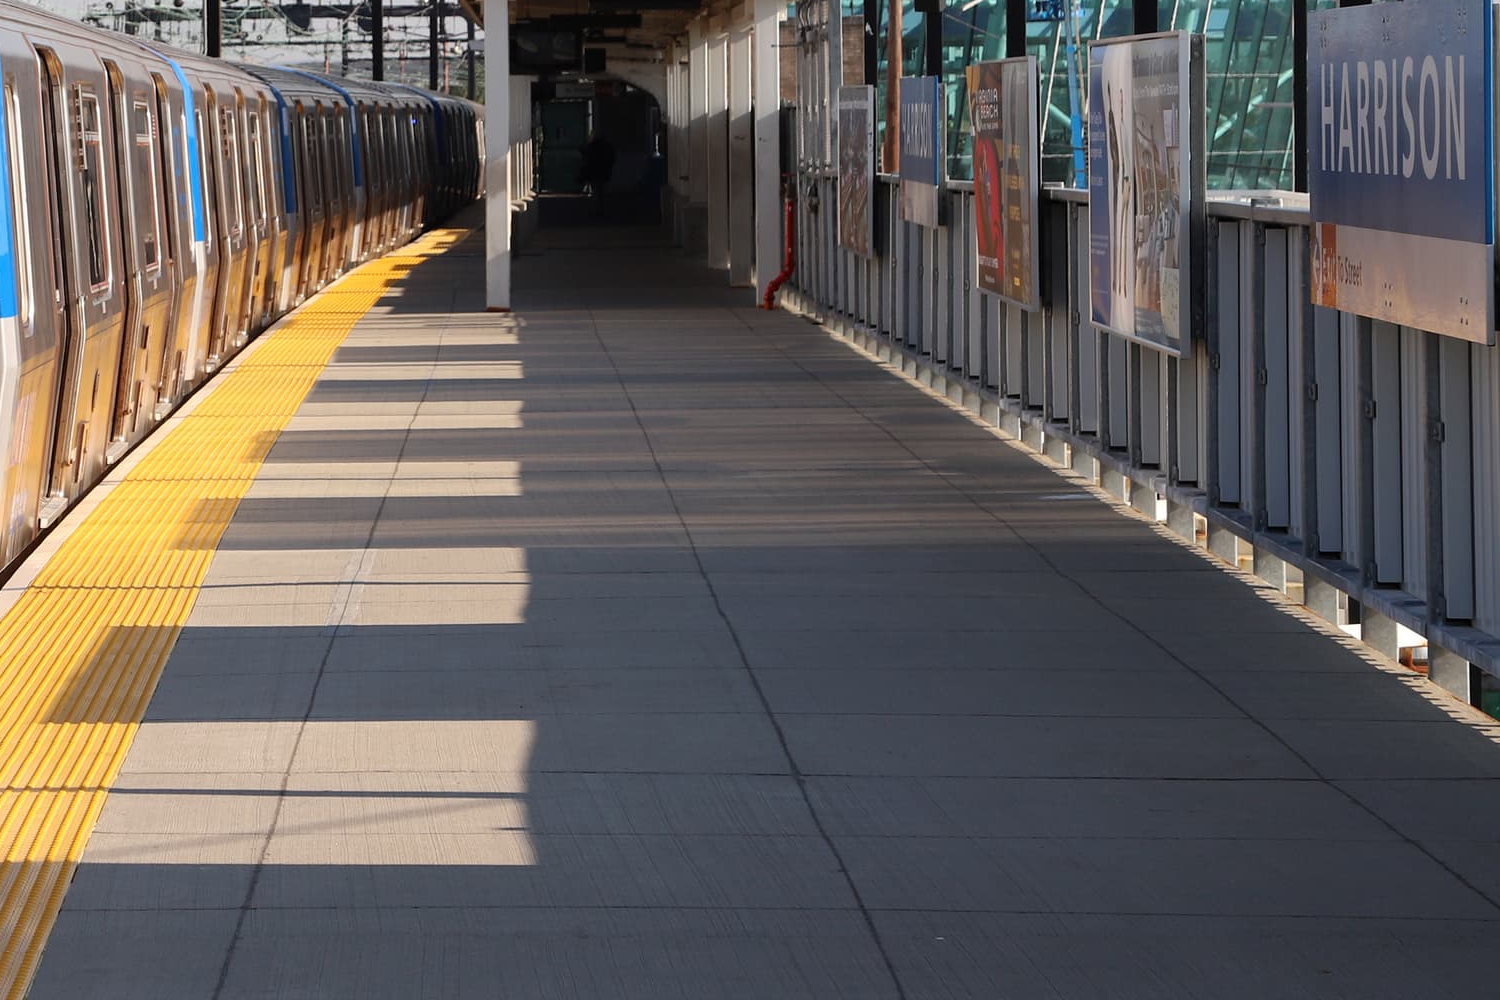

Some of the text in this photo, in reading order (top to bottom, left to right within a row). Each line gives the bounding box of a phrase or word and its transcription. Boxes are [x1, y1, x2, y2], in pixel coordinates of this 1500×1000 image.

[901, 102, 933, 158] HARRISON
[1321, 55, 1466, 180] HARRISON
[1344, 256, 1363, 288] Street
